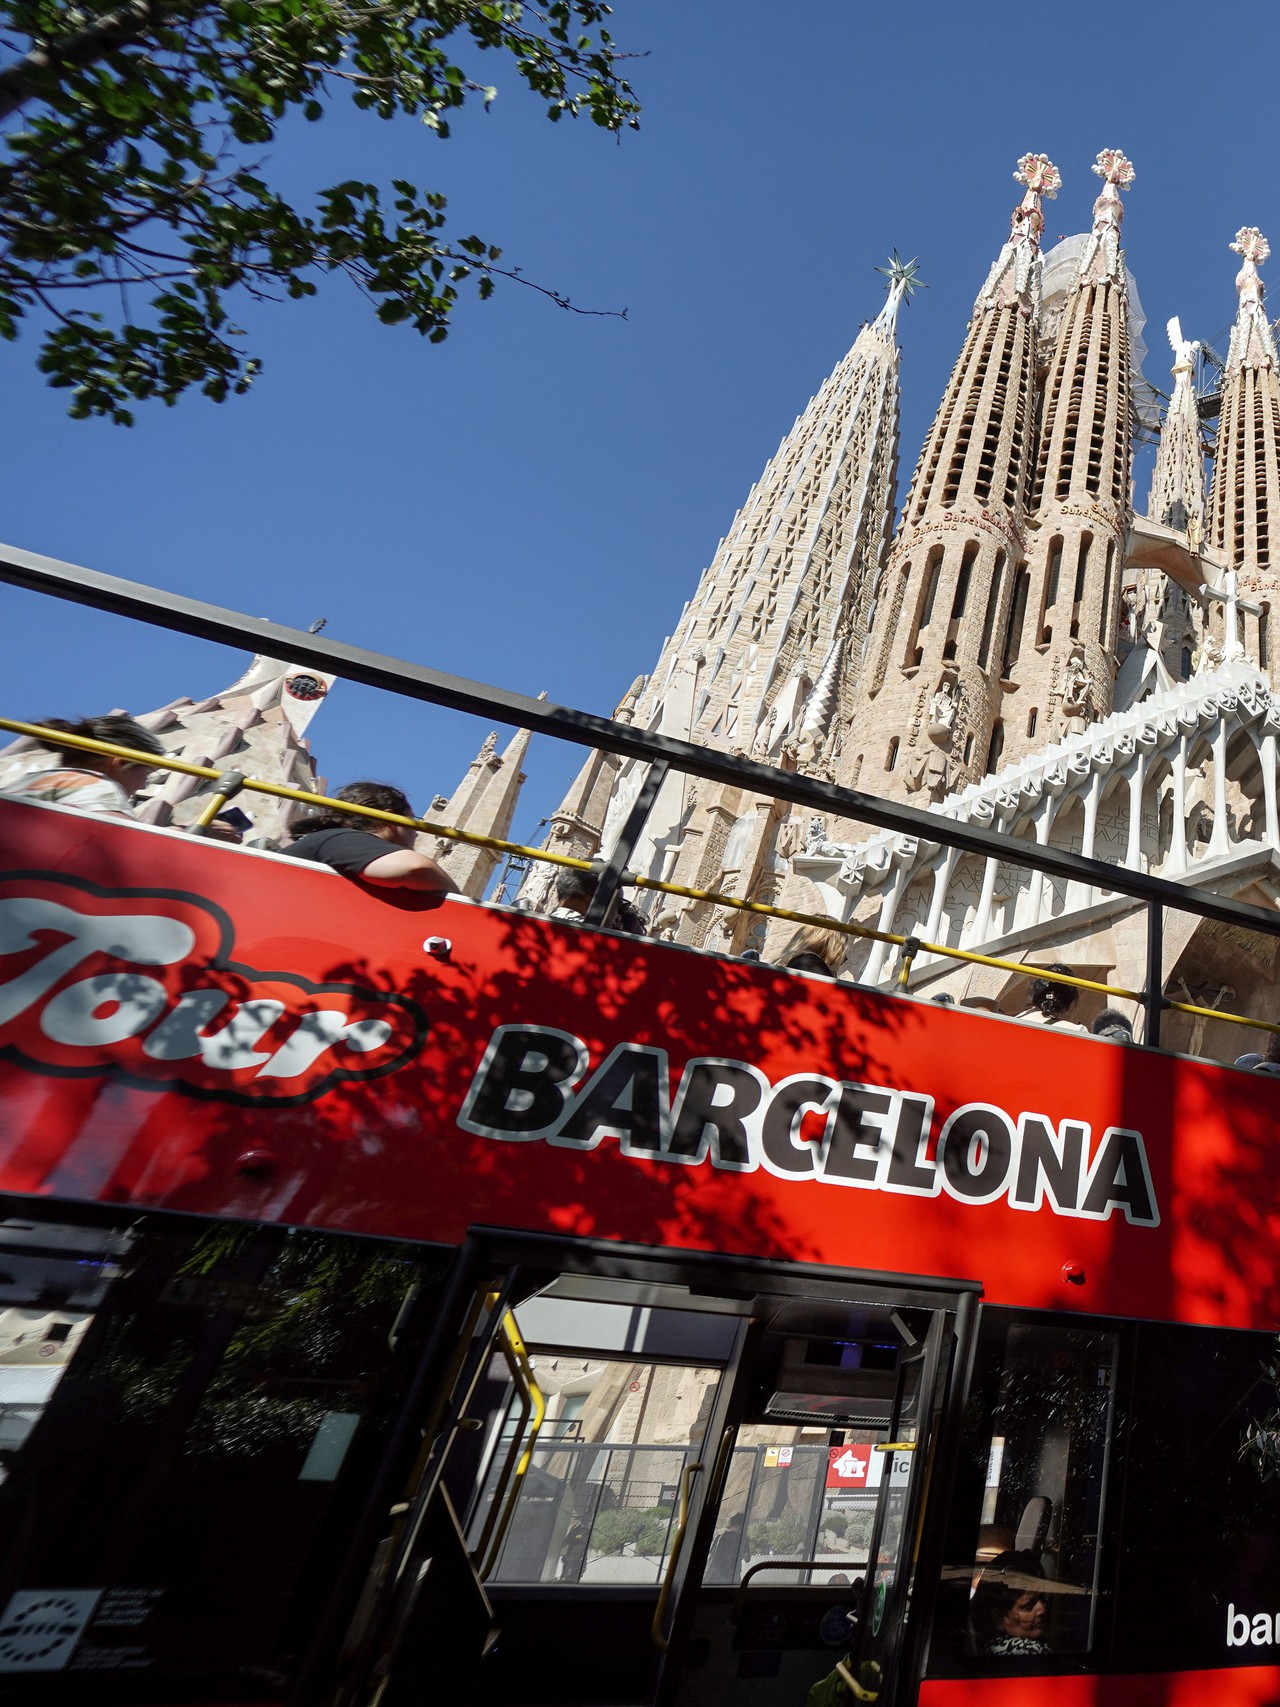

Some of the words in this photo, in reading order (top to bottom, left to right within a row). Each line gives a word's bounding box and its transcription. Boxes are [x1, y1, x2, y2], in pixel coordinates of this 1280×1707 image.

[912, 522, 957, 539] Sanctus
[943, 512, 993, 534] Sanctus
[1019, 696, 1218, 797] NAZARENUS
[0, 897, 392, 1078] Tour
[457, 1023, 1161, 1229] BARCELONA
